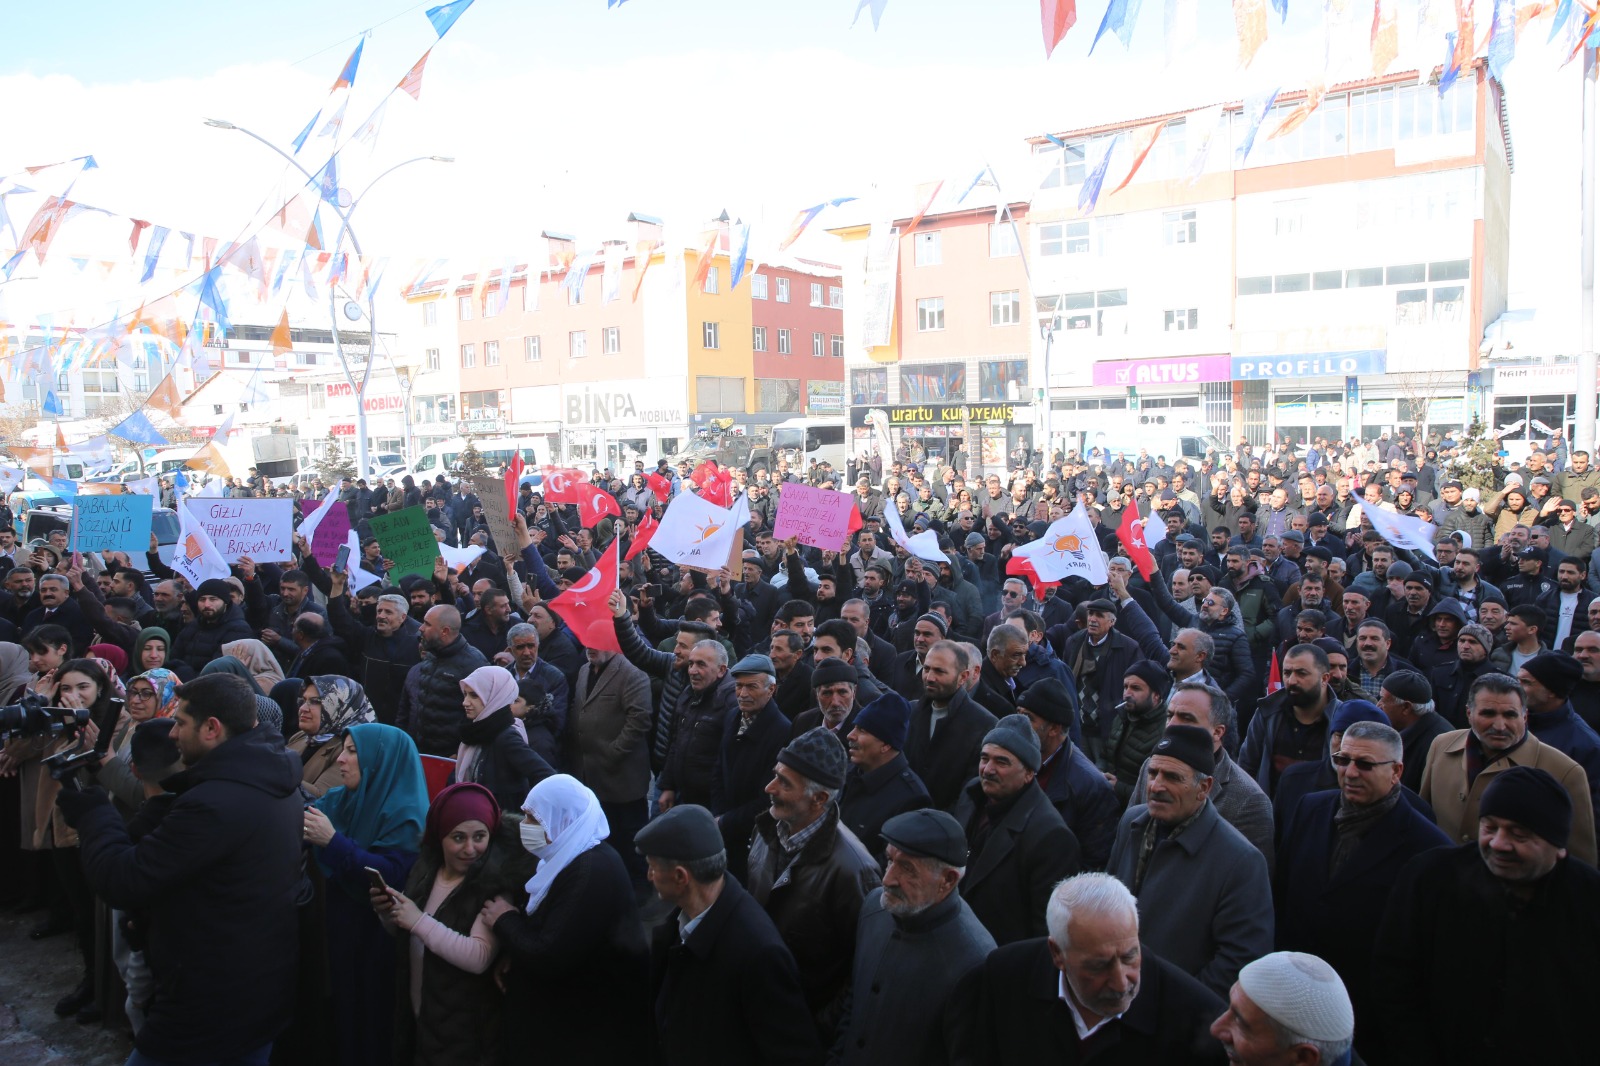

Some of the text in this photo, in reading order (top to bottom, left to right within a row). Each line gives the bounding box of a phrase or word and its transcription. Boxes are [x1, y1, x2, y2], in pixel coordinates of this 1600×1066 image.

[1136, 363, 1199, 383] ALTUS
[640, 406, 682, 422] MOBİLYA
[892, 406, 933, 421] urartu
[784, 487, 840, 507] SANA VEFA
[76, 498, 129, 515] BABALAR
[210, 504, 243, 518] GİZLİ
[77, 517, 132, 533] SÖZÜNÜ
